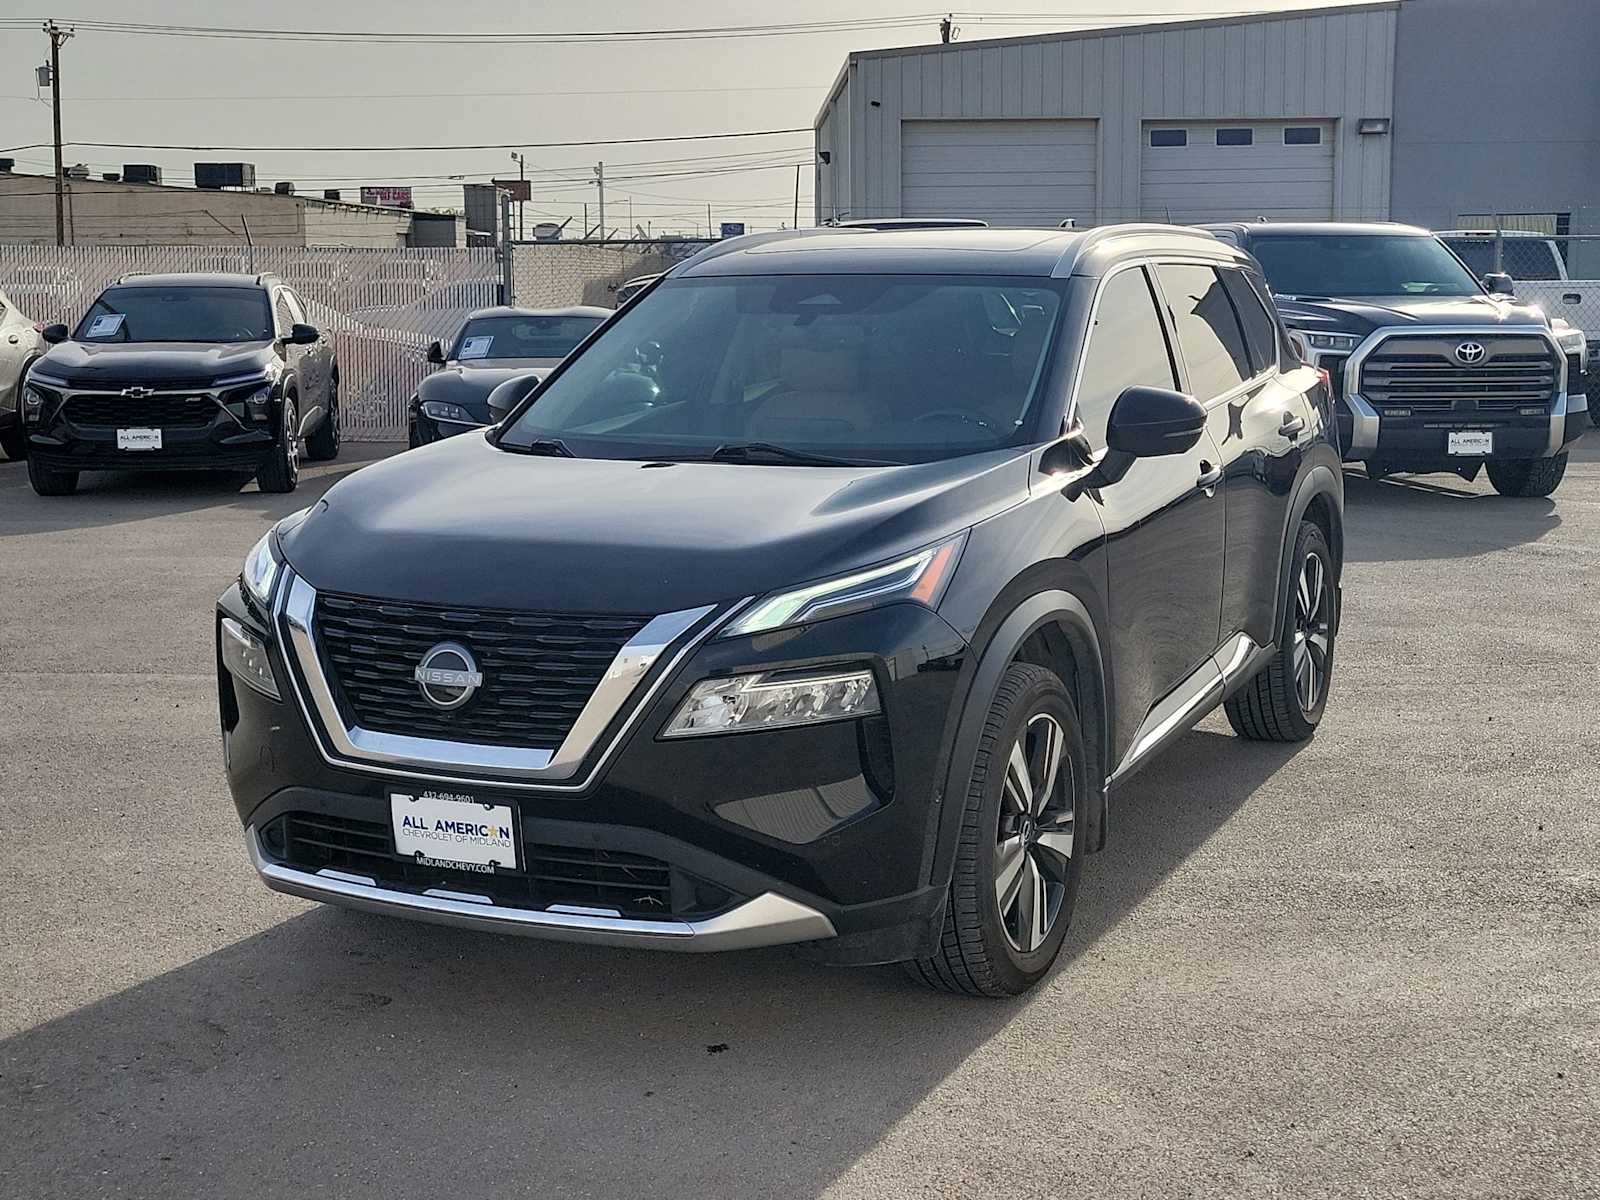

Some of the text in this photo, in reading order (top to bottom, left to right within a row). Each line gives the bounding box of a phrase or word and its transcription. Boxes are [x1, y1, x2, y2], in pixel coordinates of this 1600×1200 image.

[415, 669, 481, 684] NISSAN
[422, 790, 475, 804] 432-694-9601
[402, 815, 429, 830] ALL
[402, 828, 511, 848] CHEVROLET OF MIDLAND
[416, 857, 495, 874] MIDLANDCHEVY.COM
